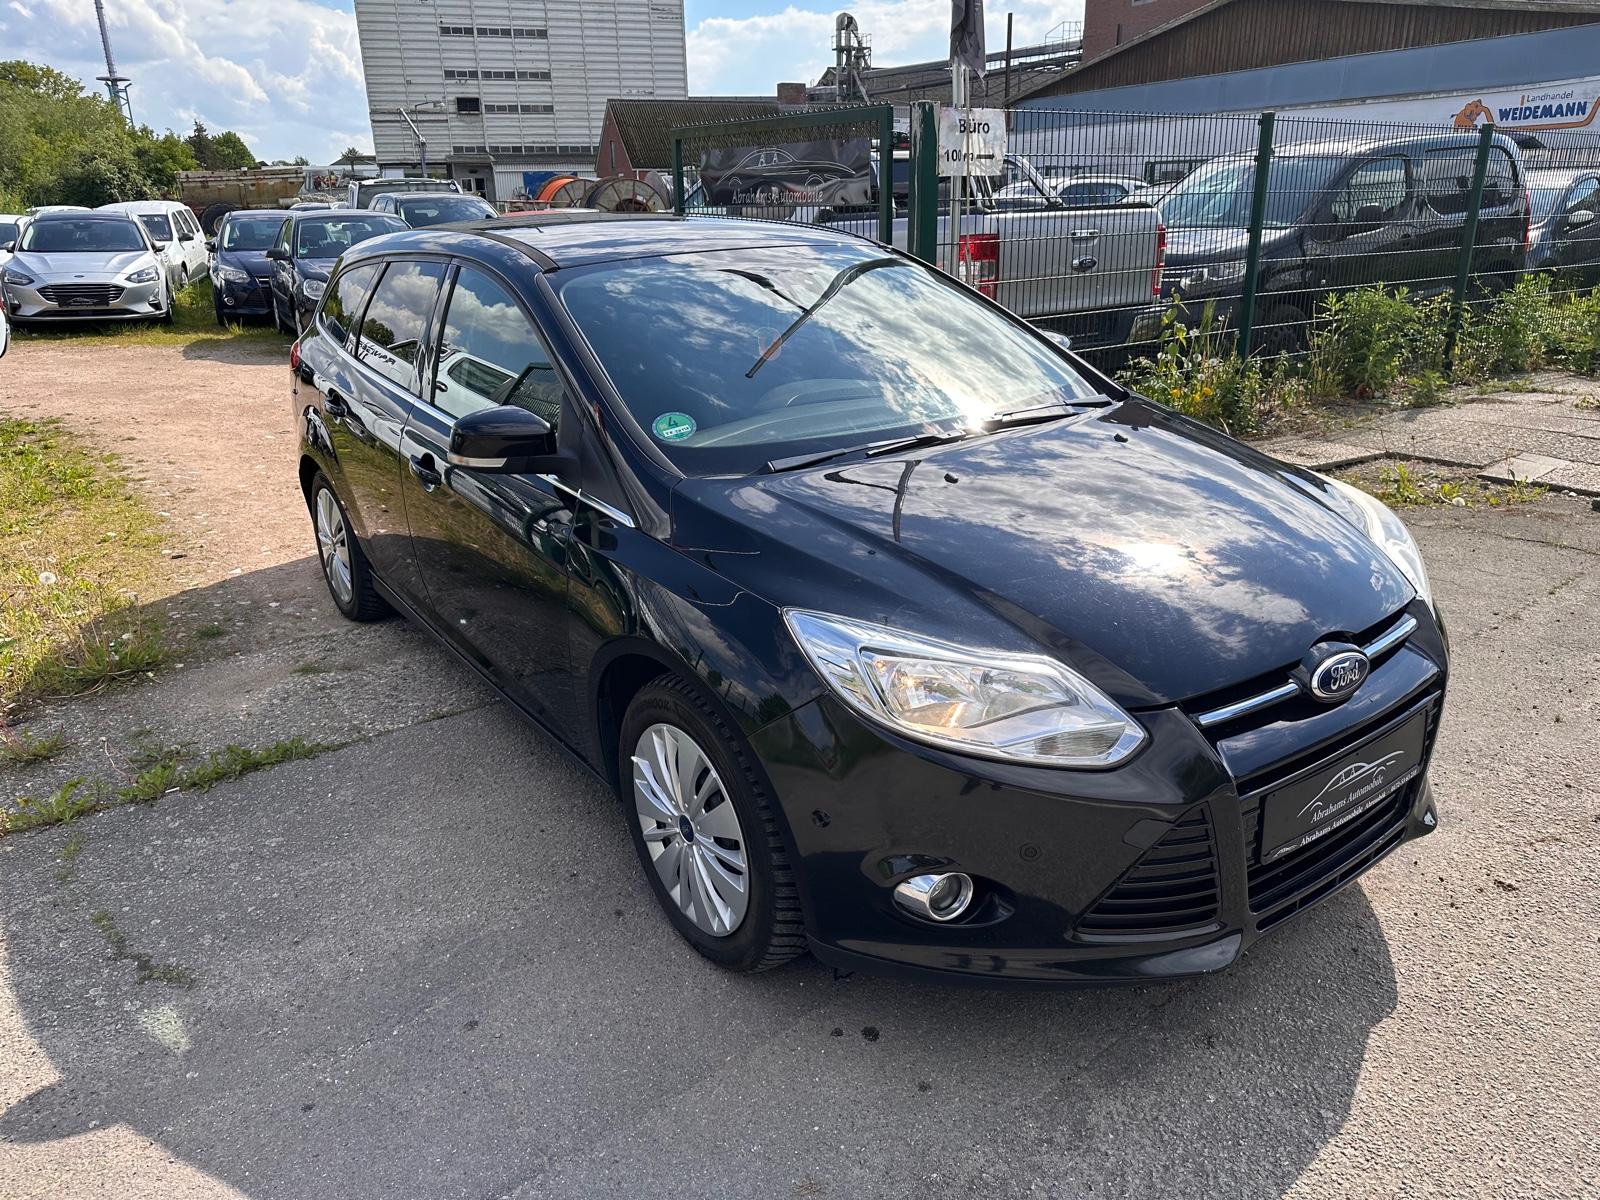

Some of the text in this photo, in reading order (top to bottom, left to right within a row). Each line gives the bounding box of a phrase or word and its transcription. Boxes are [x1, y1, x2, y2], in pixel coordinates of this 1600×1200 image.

[1526, 90, 1574, 103] Landhandel
[1498, 101, 1588, 122] WEIDEMANN
[958, 118, 990, 134] Büro
[732, 186, 824, 204] Abrahams Automobile
[668, 416, 679, 427] 4
[1330, 660, 1360, 690] Ford
[1310, 797, 1348, 824] Abrahams
[1347, 775, 1384, 806] Automobile
[1300, 804, 1364, 846] Abrahams Automobile
